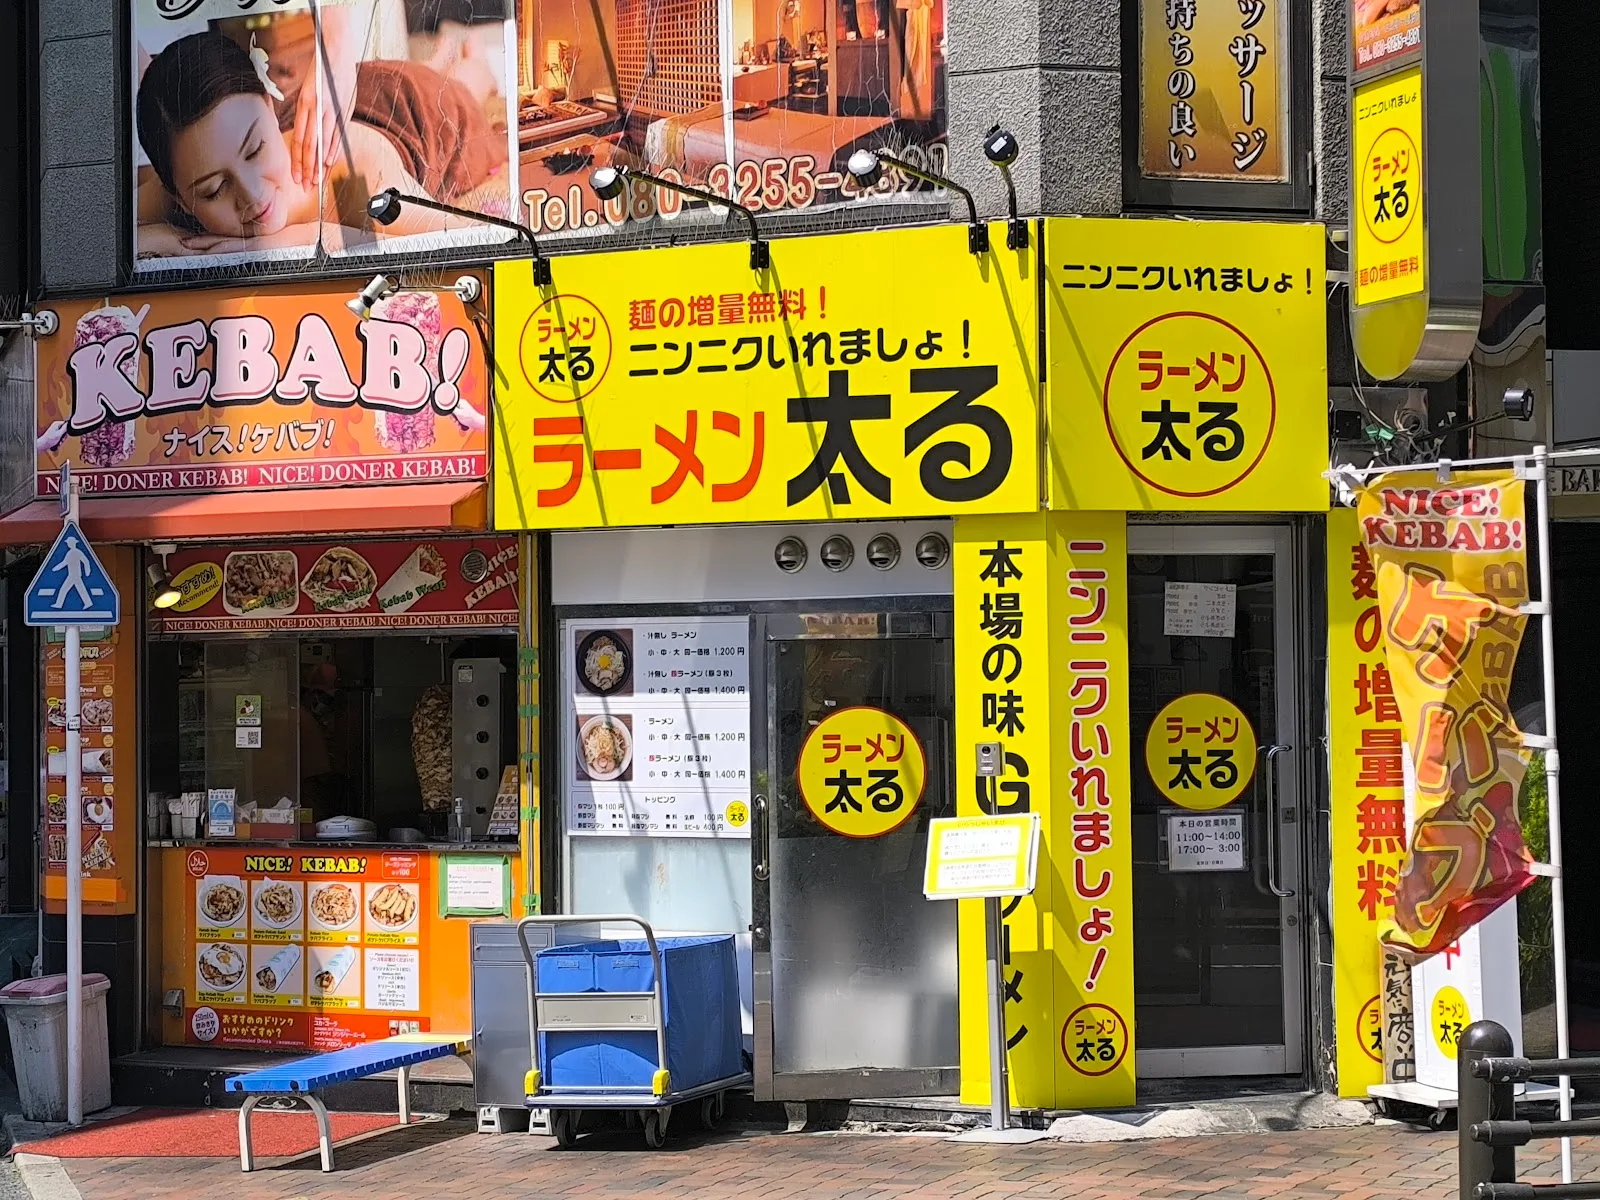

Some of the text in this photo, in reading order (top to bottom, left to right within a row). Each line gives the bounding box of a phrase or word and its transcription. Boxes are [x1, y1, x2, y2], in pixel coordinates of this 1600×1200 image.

[1359, 92, 1417, 120] ニンニクいれましょ
[1372, 148, 1411, 182] ラーメン
[1373, 181, 1409, 224] 太る
[1062, 265, 1313, 295] ニンニクいれましょ！
[537, 315, 597, 343] ラーメン
[629, 319, 972, 377] ニンニクいれましょ！
[67, 313, 470, 435] KEBAB!
[539, 346, 596, 382] 太る
[1138, 350, 1246, 393] ラーメン
[1141, 399, 1245, 462] 太る
[46, 457, 476, 493] NE! DONER KEBAB! NICE! DONER KEBAB!
[1382, 487, 1500, 517] NICE!
[1362, 516, 1523, 551] KEBAB!
[379, 578, 447, 609] Kebab Wrap
[166, 614, 518, 631] NICE! DONER KEBAB! NICE! DONER KEBAB! NICE! DONER KEBAB! NICE!
[1166, 716, 1239, 744] ラーメン
[822, 733, 905, 763] ラーメン
[1168, 749, 1239, 790] 太る
[824, 769, 904, 814] 太る
[1179, 818, 1237, 828] 本日の営業時間
[245, 855, 367, 874] NICE! KEBAB!
[222, 1014, 294, 1026] おすすめのドリンク
[1437, 999, 1465, 1018] ラーメン
[1075, 1019, 1116, 1035] ラーメン
[1076, 1038, 1116, 1062] 太る
